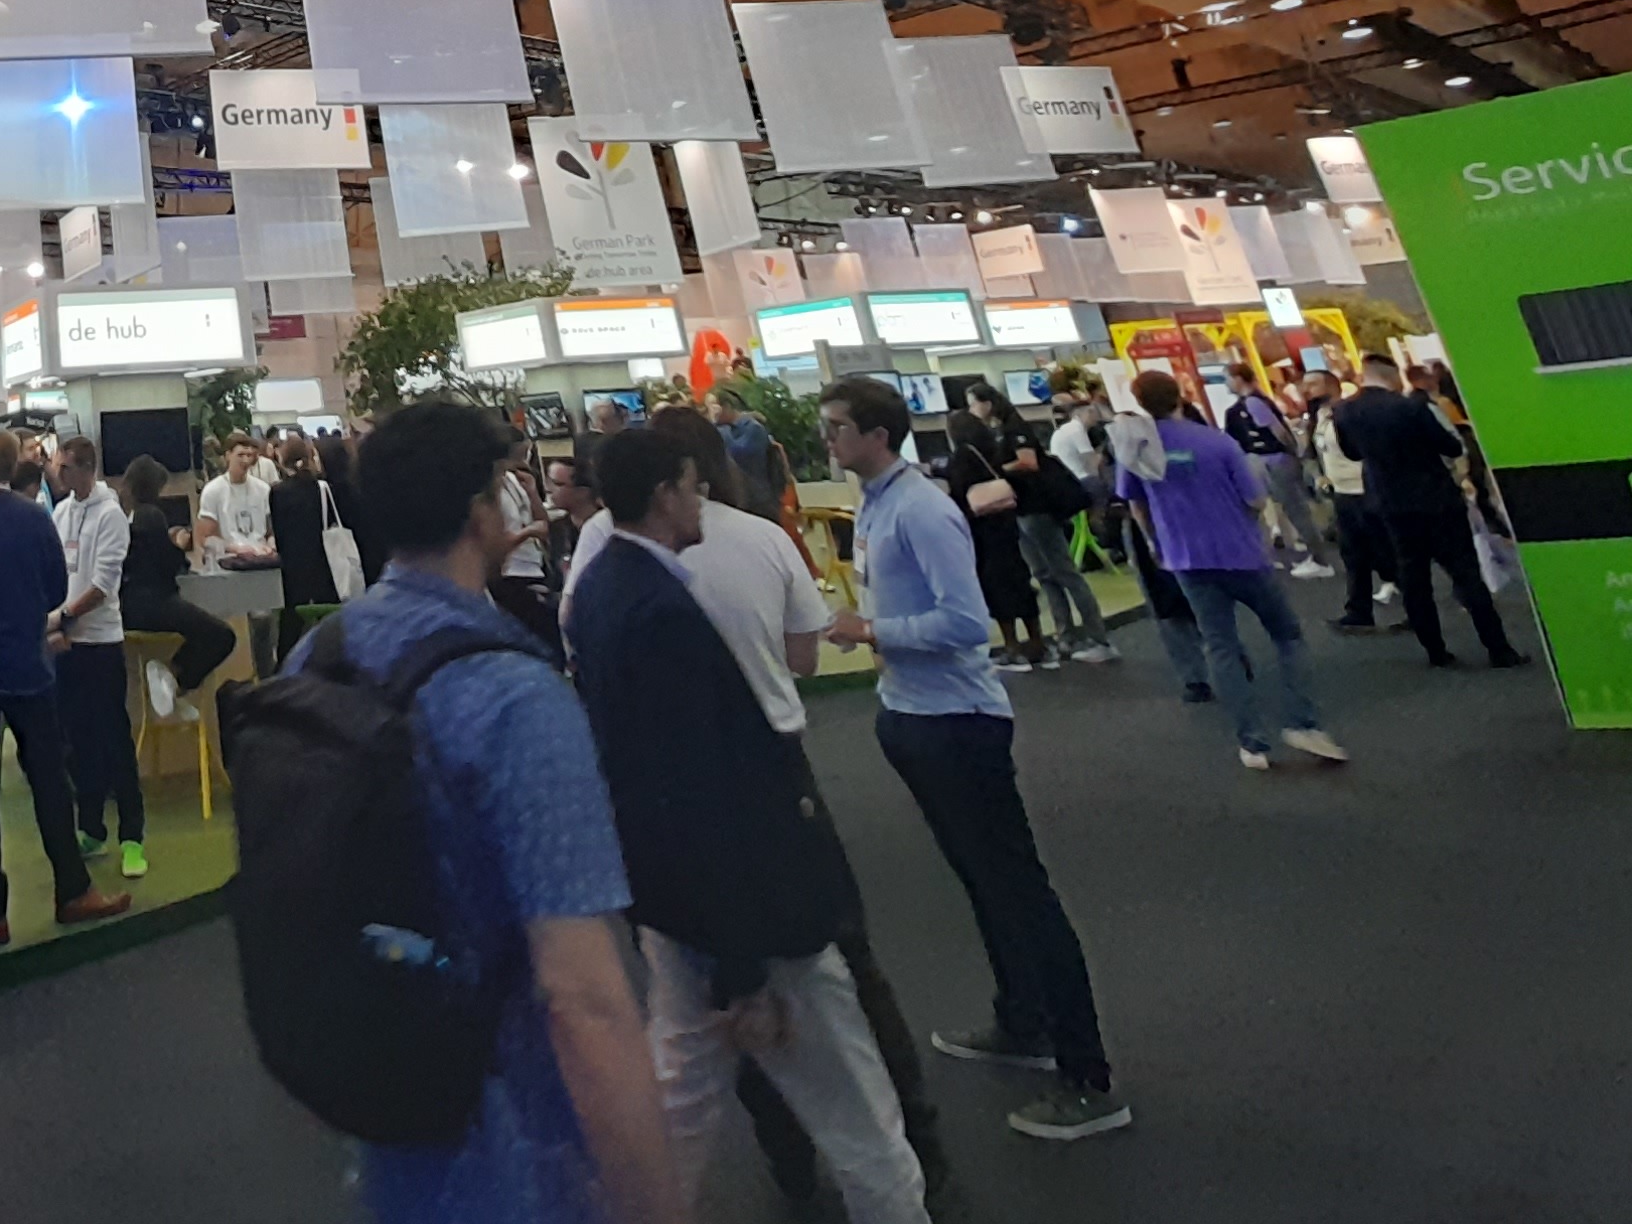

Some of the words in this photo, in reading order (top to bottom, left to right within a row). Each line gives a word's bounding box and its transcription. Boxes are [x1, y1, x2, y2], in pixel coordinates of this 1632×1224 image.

[222, 104, 332, 130] Germany
[1019, 95, 1101, 120] Germany
[572, 236, 623, 250] German
[625, 233, 656, 249] Park
[69, 318, 96, 342] de
[106, 315, 147, 340] hub
